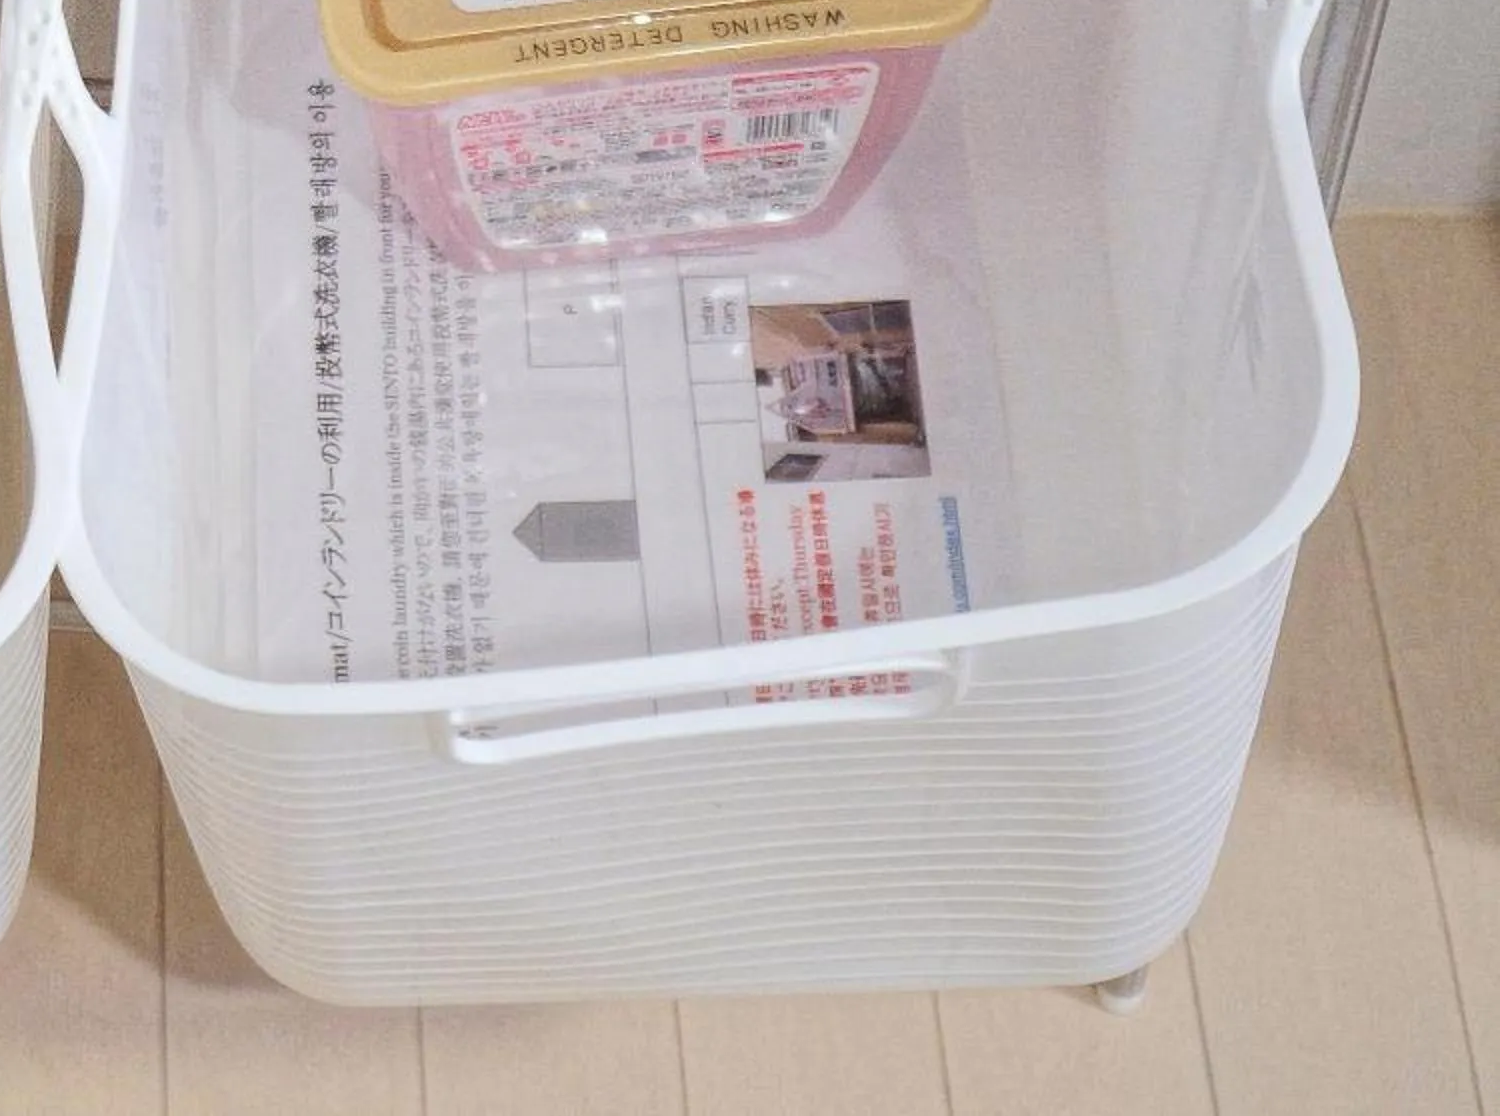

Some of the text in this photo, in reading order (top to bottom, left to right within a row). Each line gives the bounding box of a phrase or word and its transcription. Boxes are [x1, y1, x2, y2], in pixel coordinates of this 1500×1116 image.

[513, 6, 846, 64] WASHING DETERGENT
[307, 78, 336, 123] 이용
[377, 228, 395, 264] front
[378, 286, 398, 351] building
[384, 414, 400, 439] the
[385, 441, 403, 489] inside
[388, 492, 403, 506] is
[387, 509, 406, 558] which
[787, 503, 815, 635] xcept Thursday
[390, 563, 410, 627] laundry
[395, 630, 408, 666] coin
